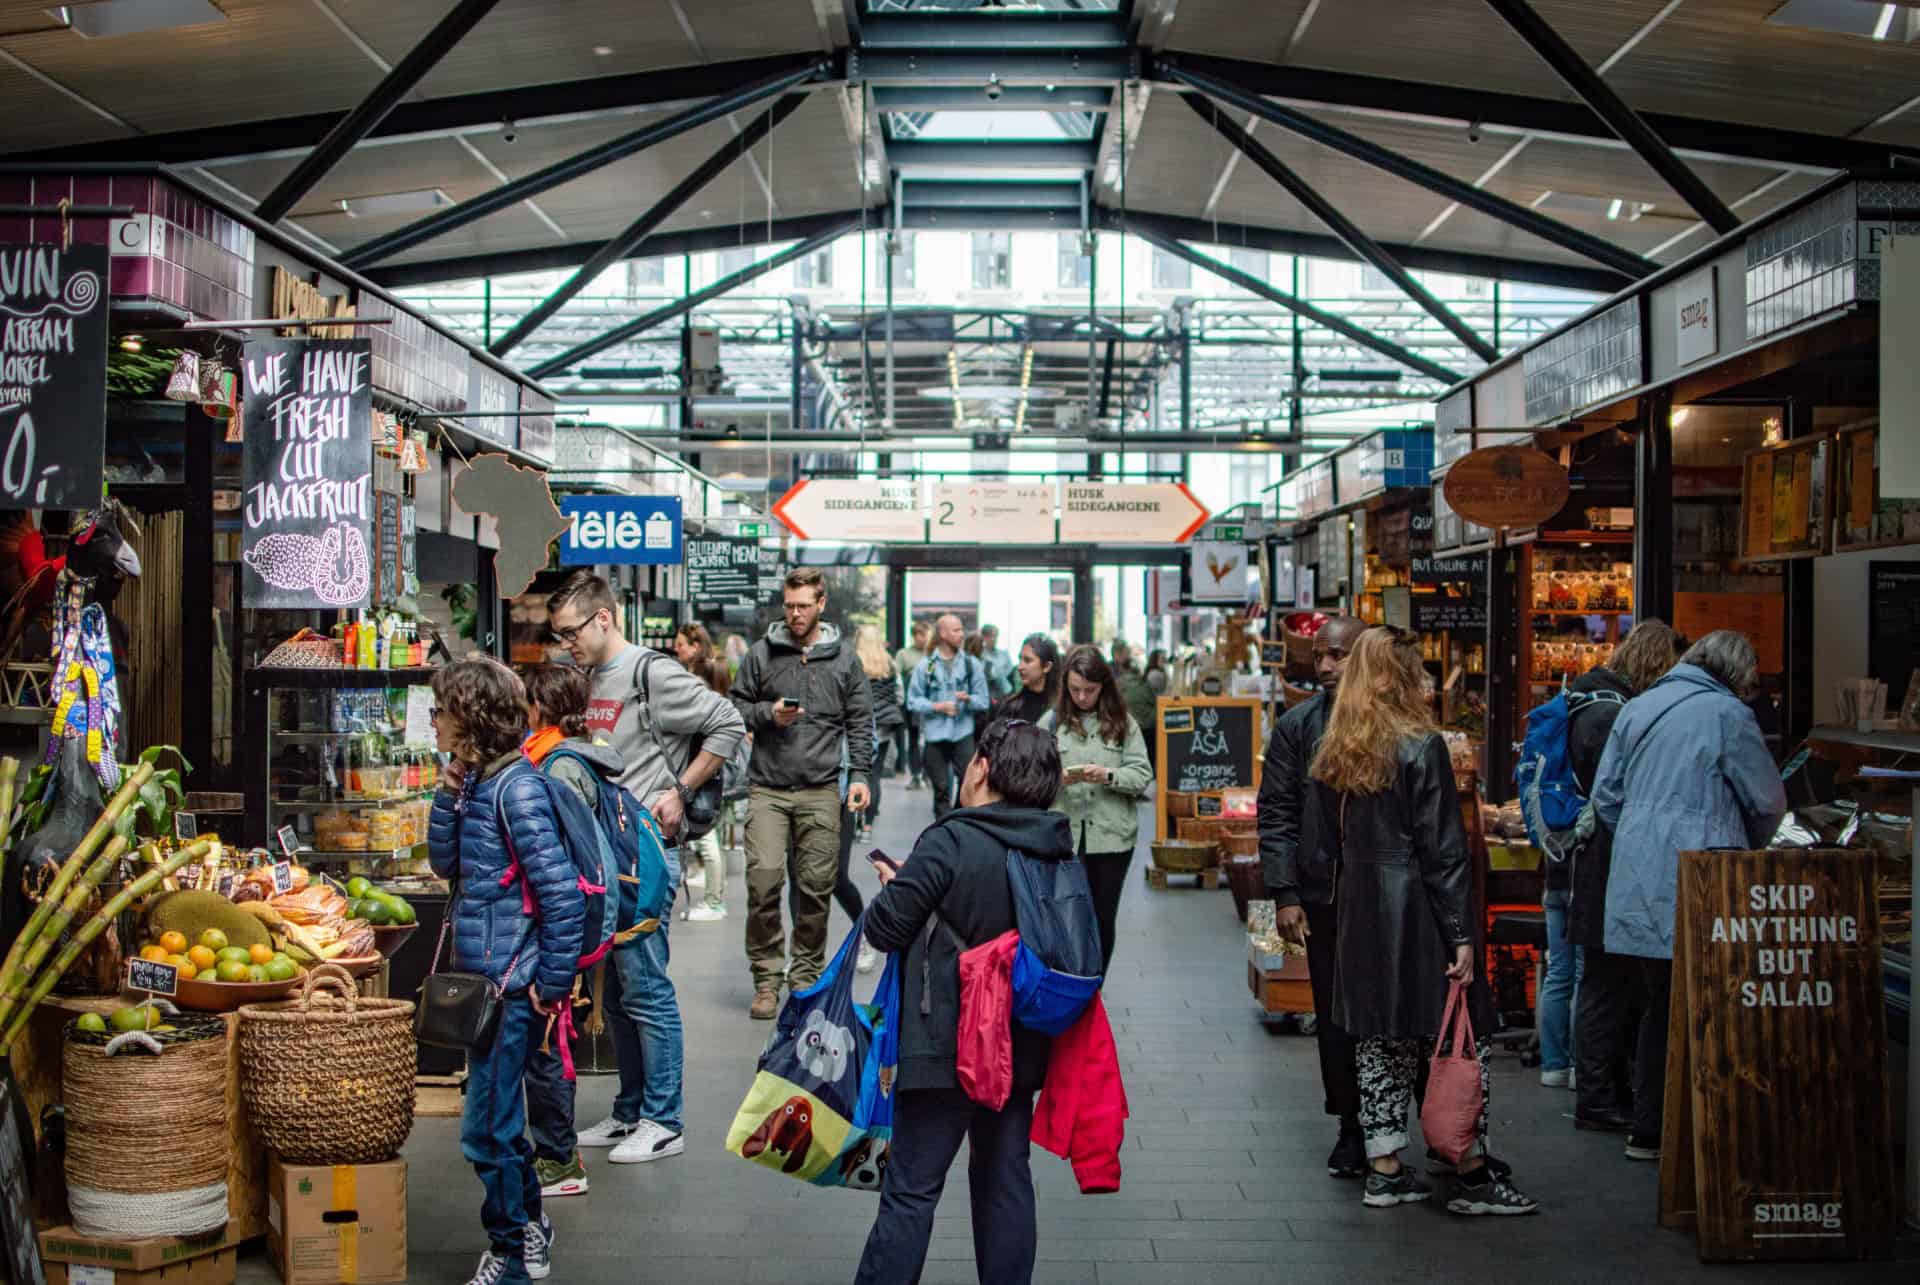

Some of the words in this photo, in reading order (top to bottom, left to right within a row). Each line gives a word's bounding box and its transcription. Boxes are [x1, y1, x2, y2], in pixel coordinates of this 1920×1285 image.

[119, 221, 141, 248] C
[0, 247, 60, 299] VIN
[0, 352, 54, 386] OREL
[247, 351, 291, 396] WE
[302, 349, 370, 395] HAVE
[266, 393, 350, 442] FRESH
[279, 439, 324, 482] CUT
[245, 472, 372, 528] JACKFRUIT
[1067, 488, 1104, 499] HUSK
[1067, 501, 1161, 513] SIDEGANGENE
[938, 500, 955, 526] 2
[570, 511, 642, 549] lêlê
[1750, 884, 1815, 911] SKIP
[1711, 916, 1857, 943] ANYTHING
[1758, 948, 1814, 975] BUT
[1741, 981, 1833, 1007] SALAD
[1754, 1203, 1842, 1229] smag
